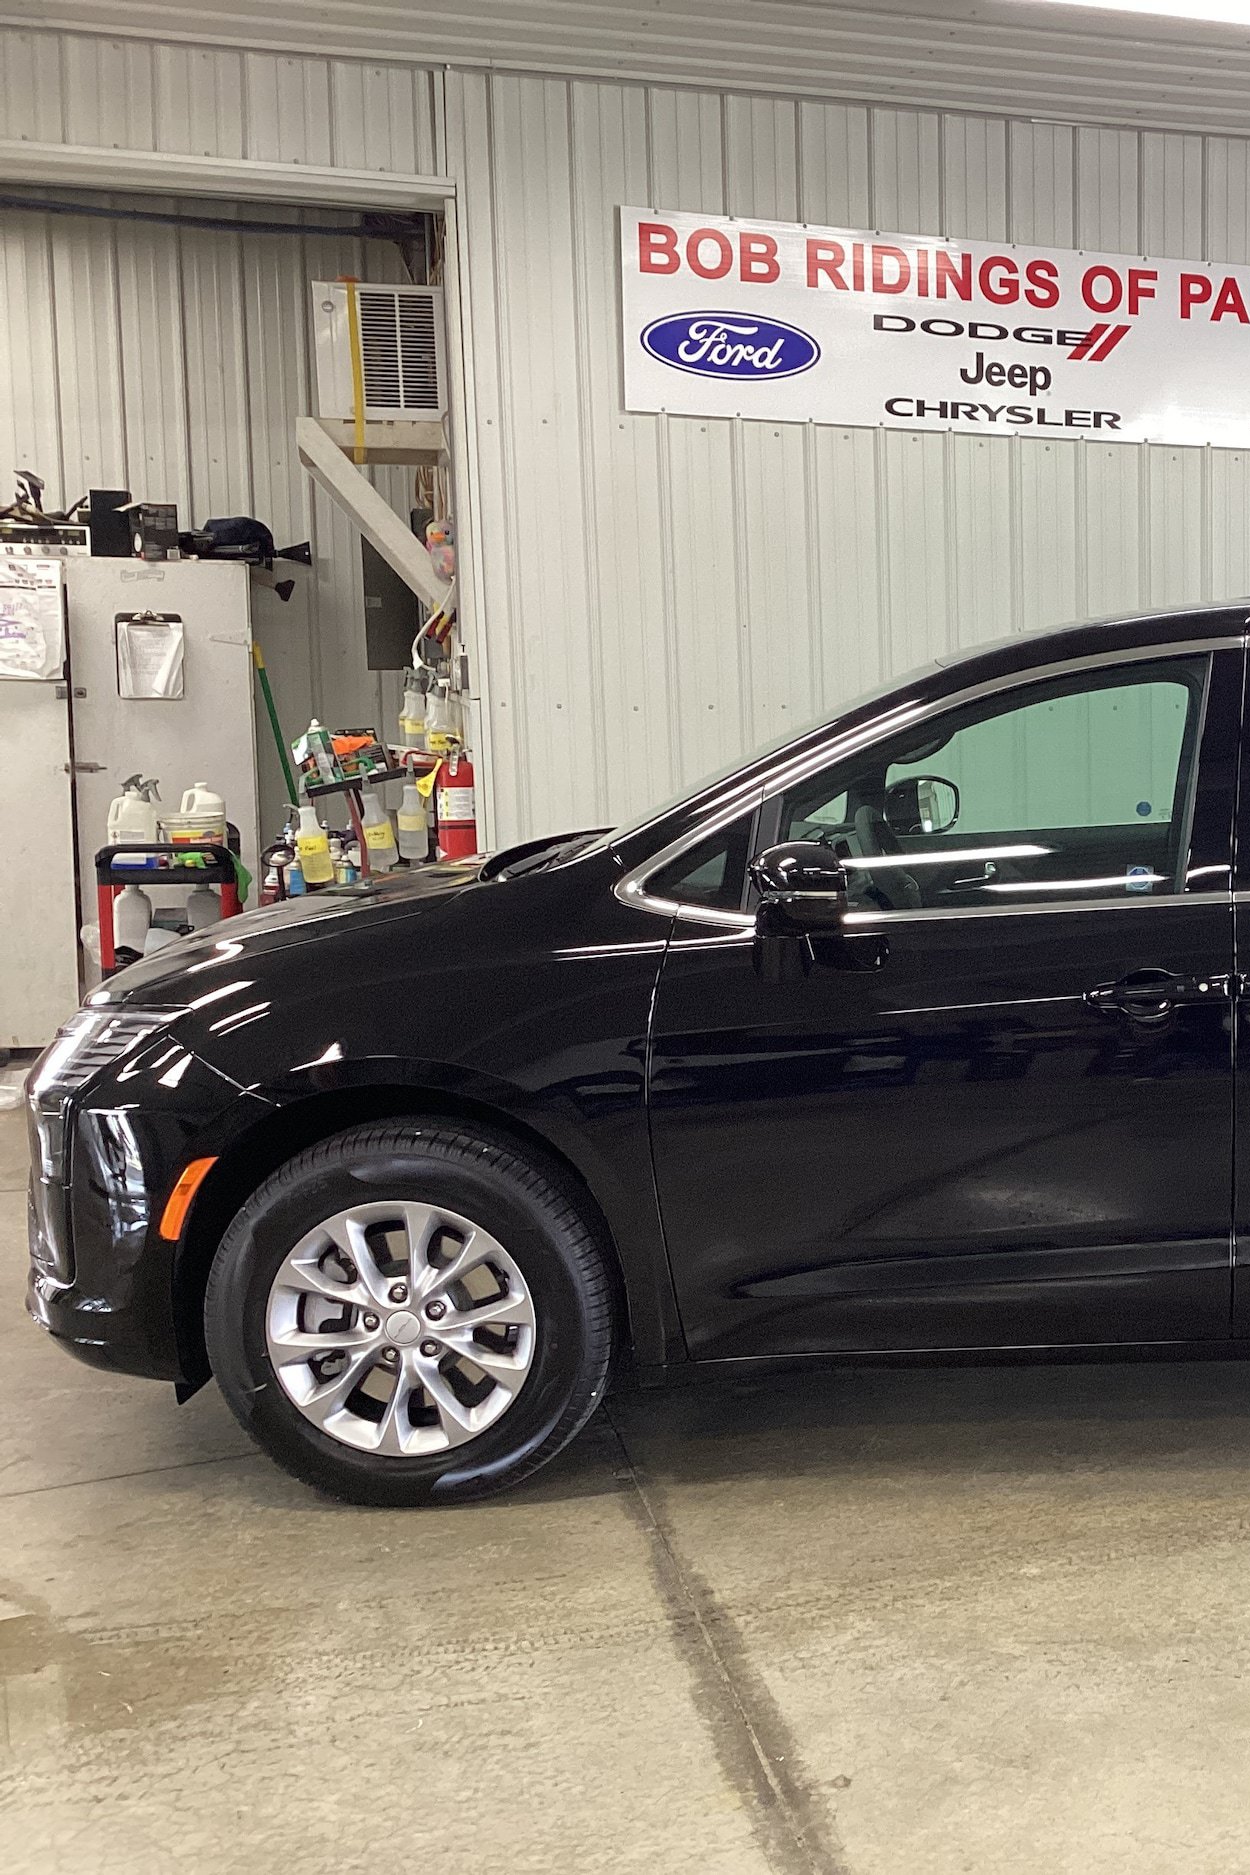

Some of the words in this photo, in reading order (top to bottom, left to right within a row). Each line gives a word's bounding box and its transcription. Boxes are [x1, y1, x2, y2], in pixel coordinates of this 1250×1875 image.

[638, 221, 781, 284] BOB
[806, 239, 1061, 309] RIDINGS
[1080, 264, 1159, 317] OF
[678, 320, 785, 369] Ford
[873, 314, 1095, 346] DODGE
[959, 351, 1052, 397] Jeep
[884, 397, 1121, 430] CHRYSLER
